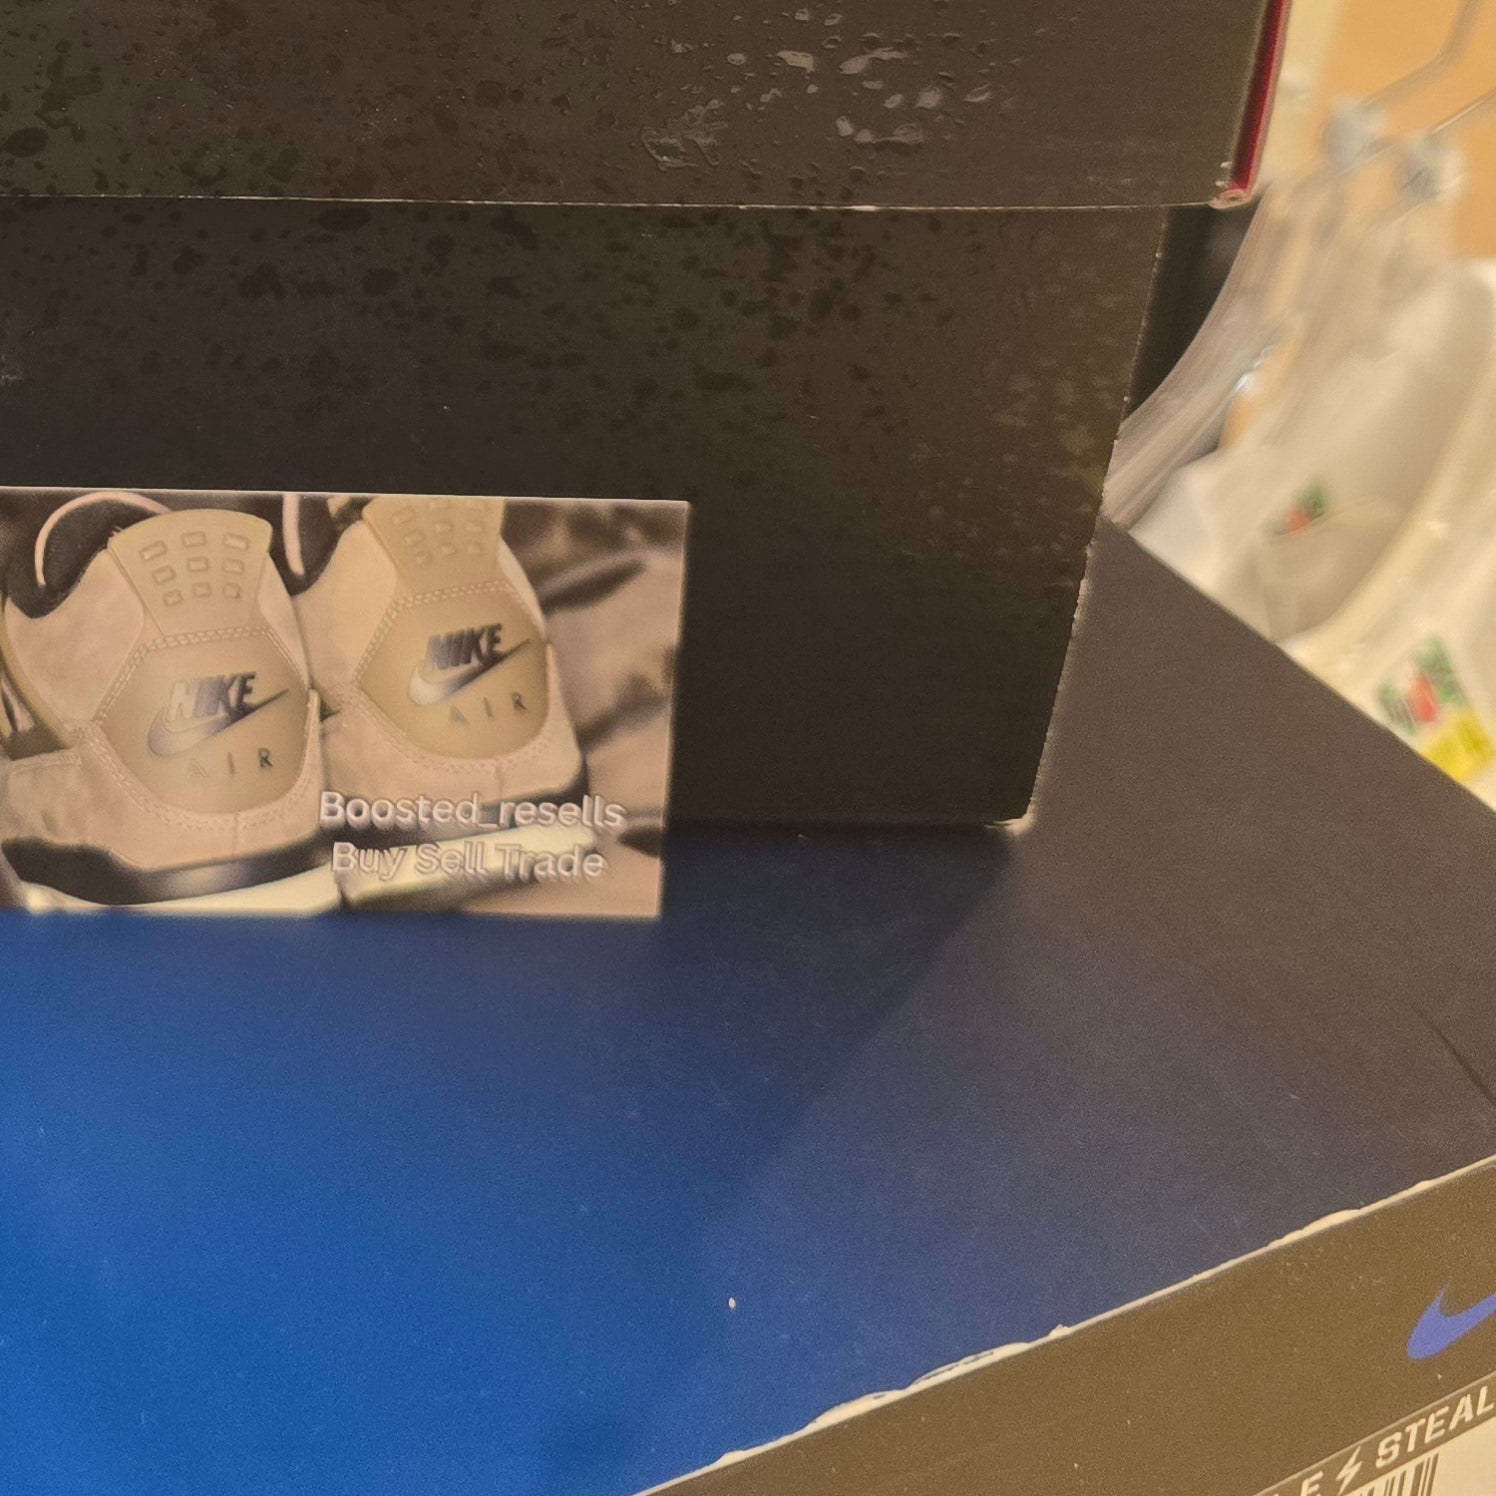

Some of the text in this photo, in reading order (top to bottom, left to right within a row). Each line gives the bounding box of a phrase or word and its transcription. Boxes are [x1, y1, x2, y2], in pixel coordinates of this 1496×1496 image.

[423, 622, 504, 672] NIKE
[164, 671, 257, 722] NIKE
[320, 791, 627, 828] Boosted_resells
[332, 840, 608, 881] Buy Sell Trade
[1375, 1385, 1496, 1469] STEAL
